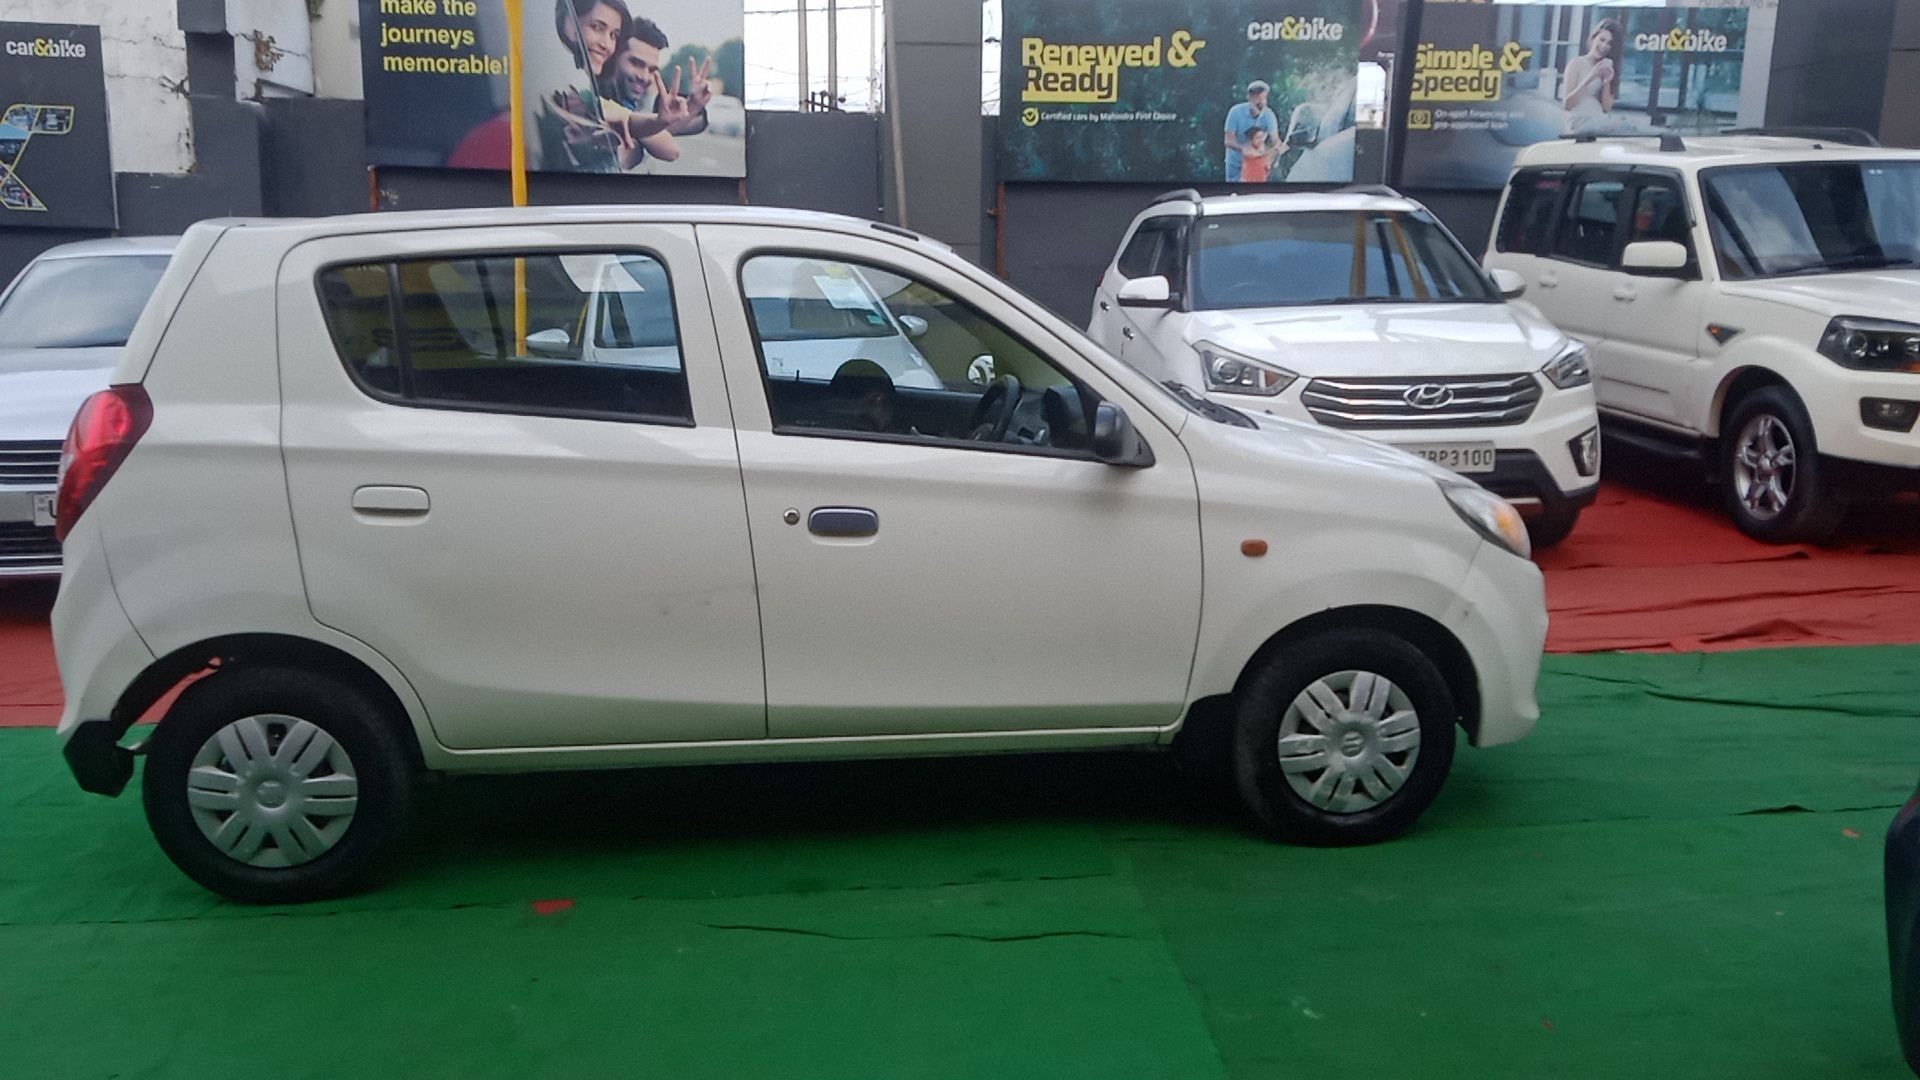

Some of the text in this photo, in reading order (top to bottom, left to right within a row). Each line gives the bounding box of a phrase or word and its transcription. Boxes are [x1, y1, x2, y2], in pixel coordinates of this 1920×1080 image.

[380, 0, 477, 16] make the
[380, 22, 475, 49] journeys
[1247, 16, 1344, 41] car&bike
[1634, 27, 1728, 52] car&bike
[5, 38, 86, 58] car&bike
[1022, 30, 1206, 68] Renewed &
[1500, 41, 1533, 73] &
[383, 54, 509, 75] memorable!
[1025, 63, 1114, 99] Ready
[1041, 111, 1072, 121] Certified
